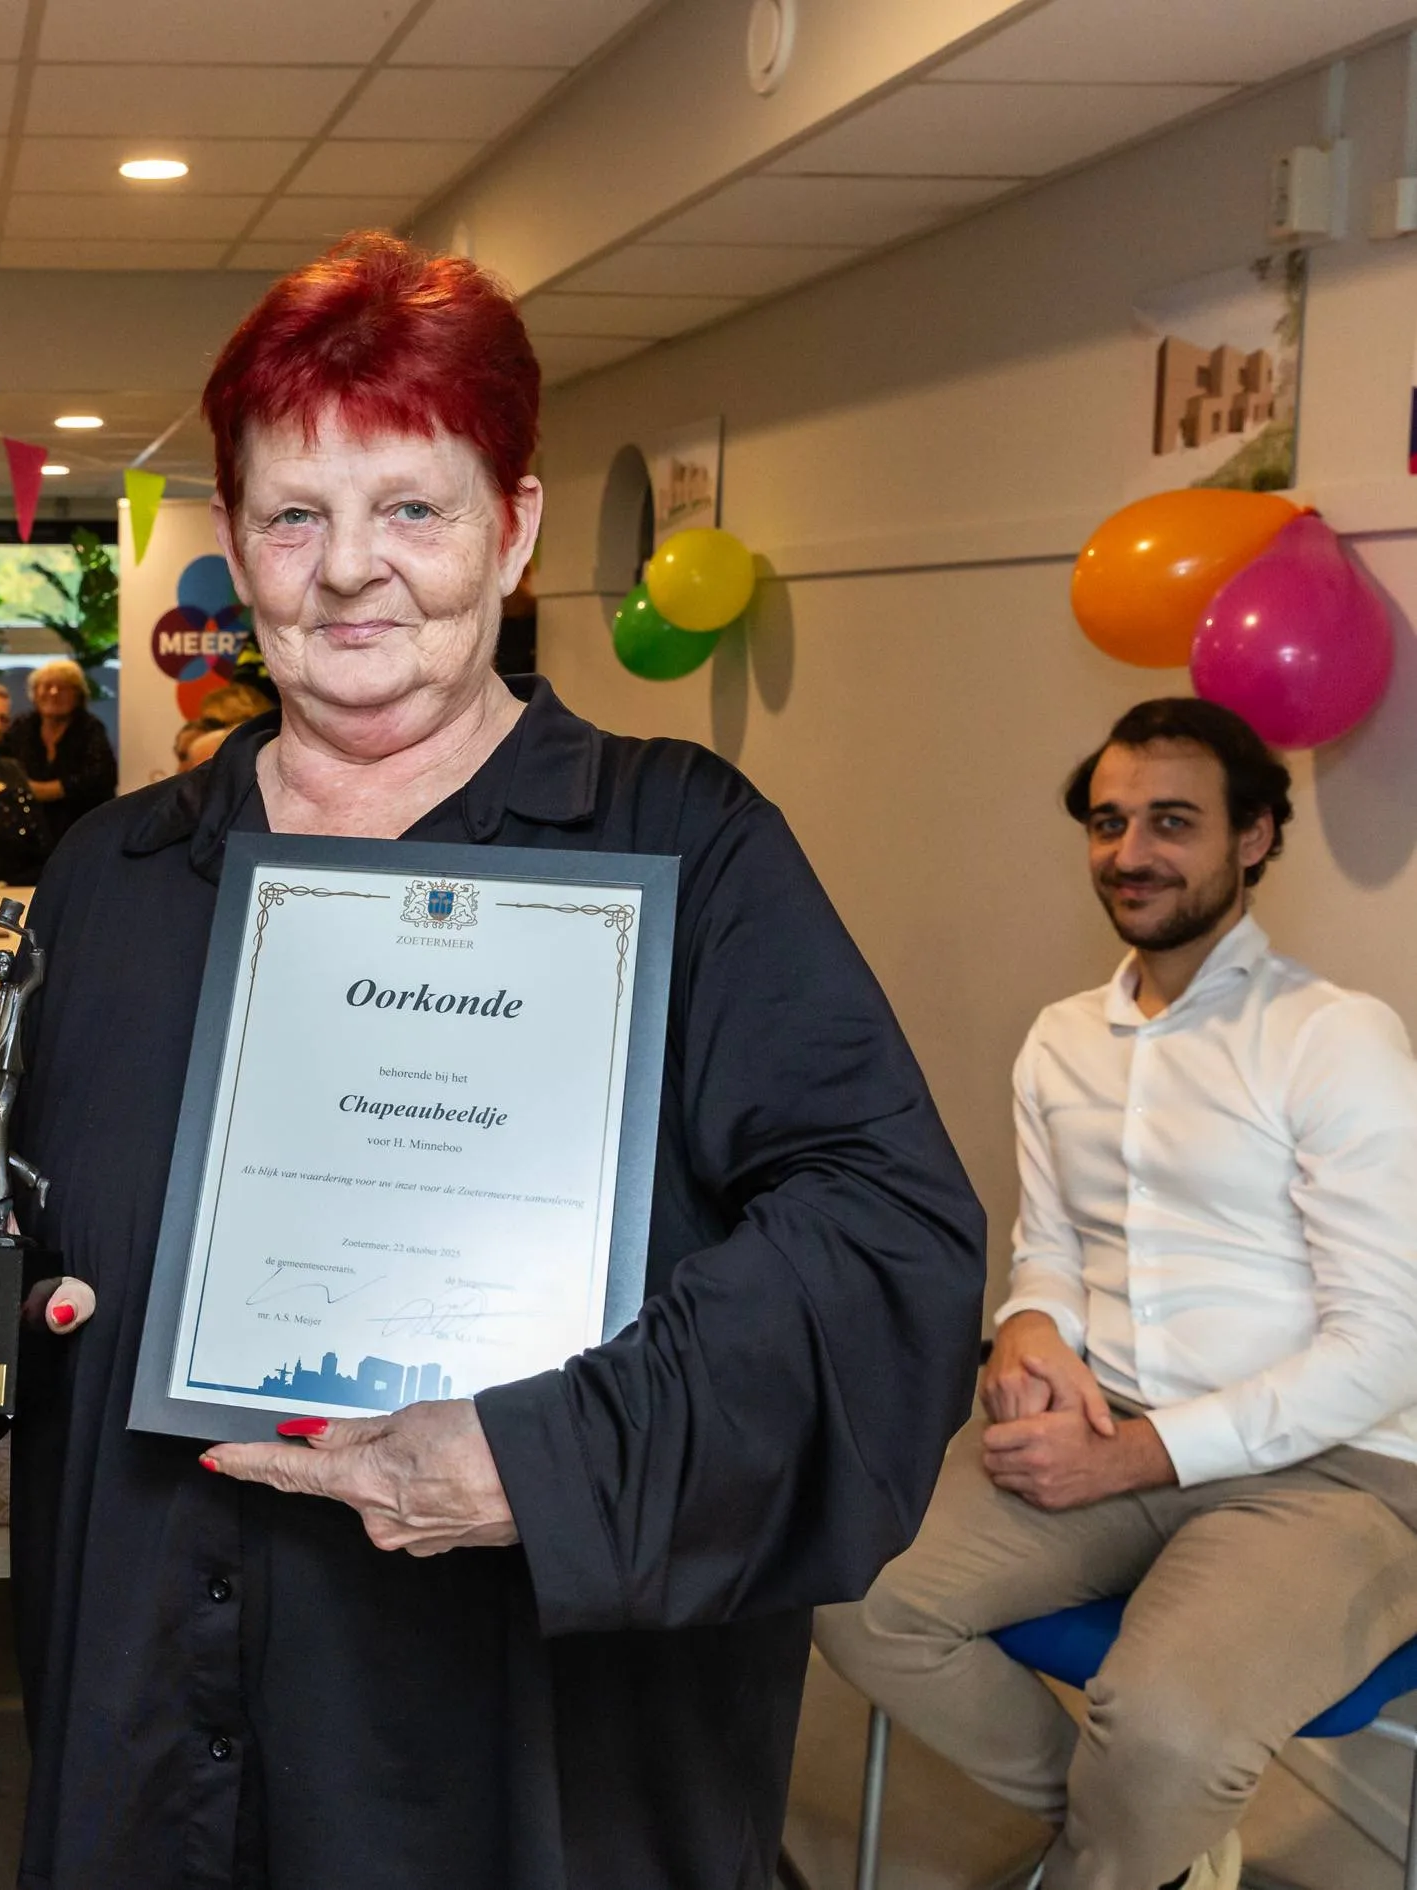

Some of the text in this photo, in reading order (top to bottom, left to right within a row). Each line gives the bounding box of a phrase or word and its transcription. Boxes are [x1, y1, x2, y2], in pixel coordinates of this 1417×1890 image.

[396, 935, 474, 949] ZOETERMEER
[346, 979, 523, 1019] Oorkonde
[379, 1066, 468, 1084] behorende bij het
[339, 1094, 508, 1129] Chapeaubeeldje
[367, 1136, 463, 1153] voor H. Minneboo
[241, 1165, 256, 1175] Als
[258, 1166, 278, 1178] blijk
[282, 1171, 297, 1179] van
[299, 1173, 353, 1185] waardering
[355, 1178, 376, 1187] voor
[378, 1179, 391, 1188] uw
[394, 1181, 417, 1191] inzet
[420, 1184, 441, 1193] voor
[443, 1185, 455, 1194] de
[265, 1256, 275, 1265] de
